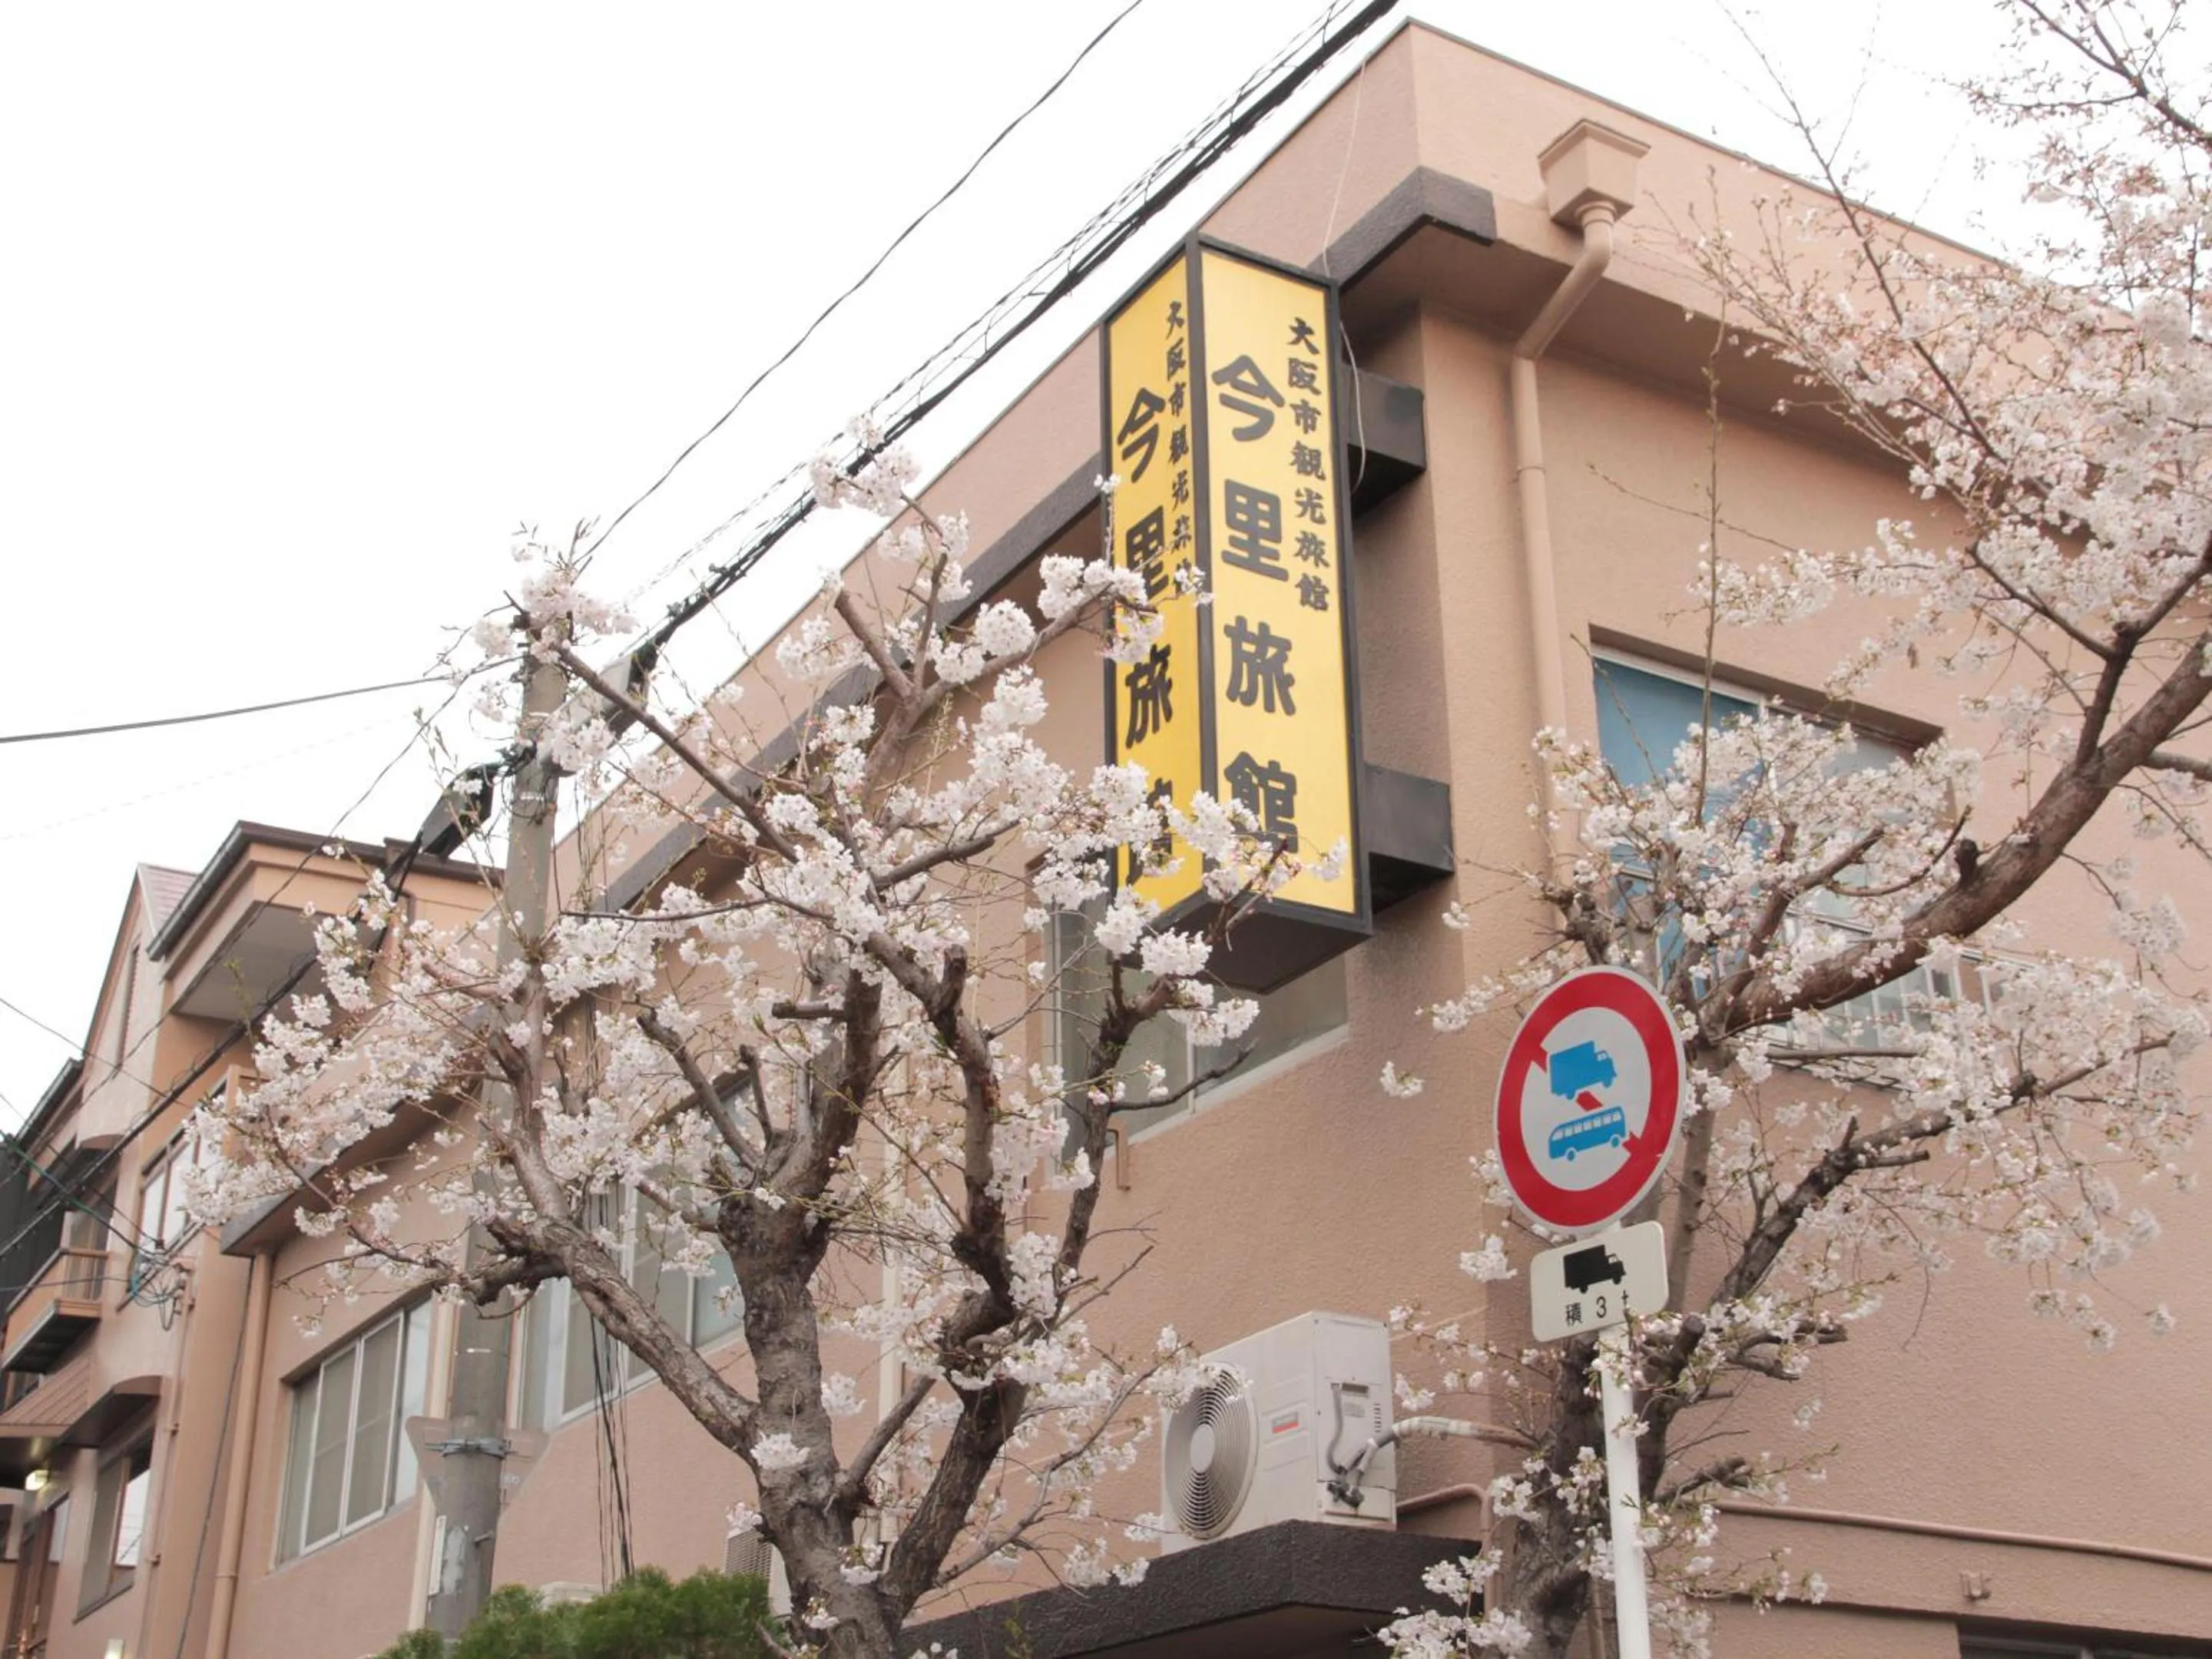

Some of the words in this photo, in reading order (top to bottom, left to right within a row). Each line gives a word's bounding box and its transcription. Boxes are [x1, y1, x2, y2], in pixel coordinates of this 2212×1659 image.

[1166, 301, 1192, 597] 大阪市観光旅
[1287, 316, 1331, 611] 大阪市観光旅館
[1211, 354, 1299, 855] 今里旅館
